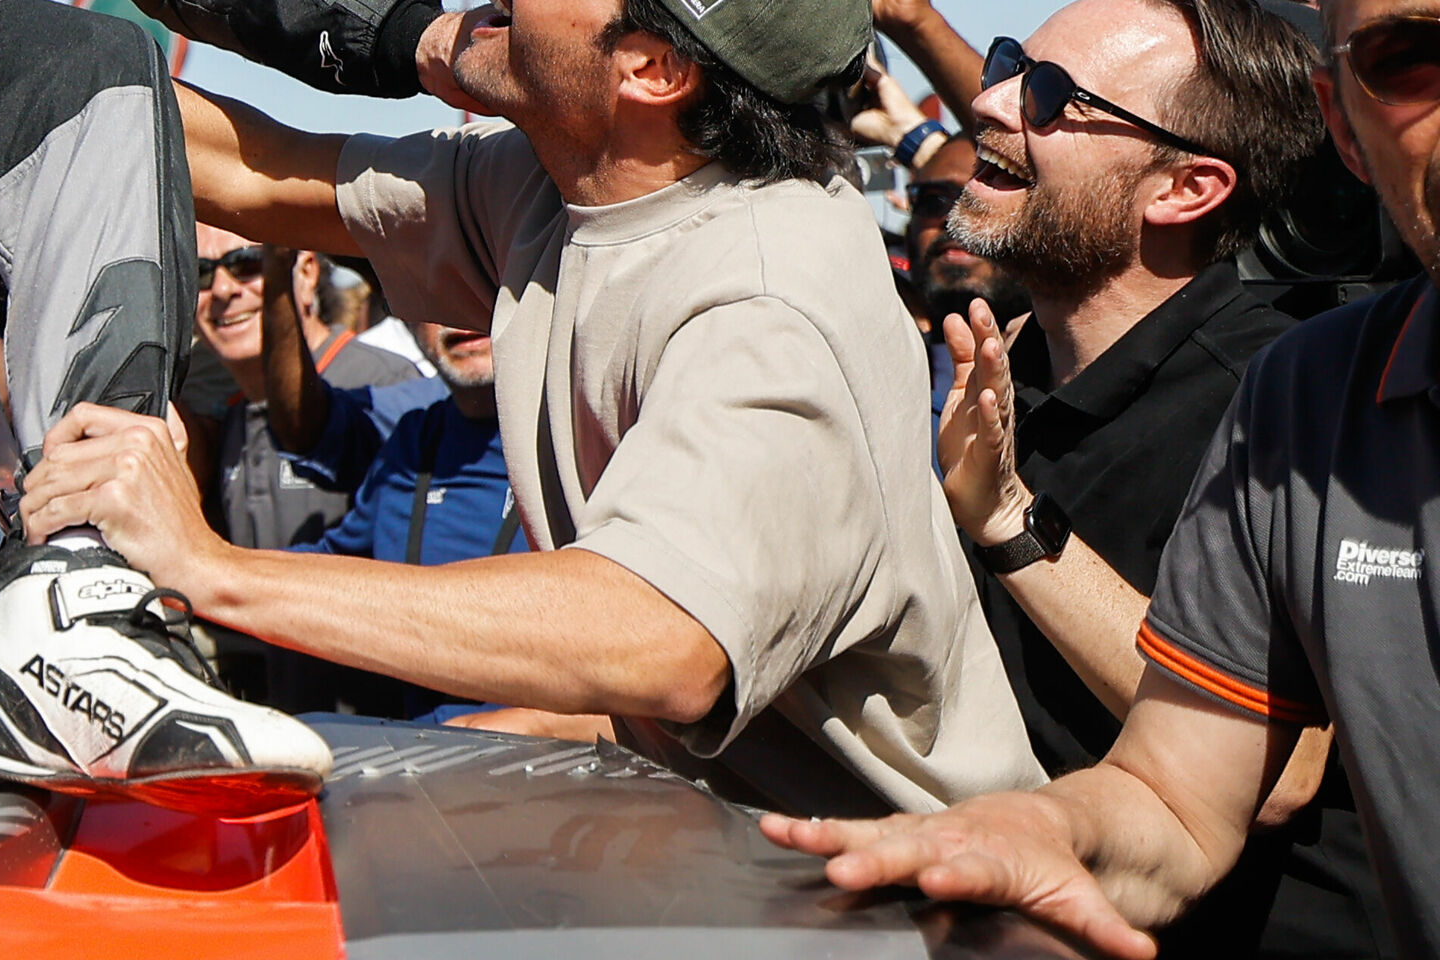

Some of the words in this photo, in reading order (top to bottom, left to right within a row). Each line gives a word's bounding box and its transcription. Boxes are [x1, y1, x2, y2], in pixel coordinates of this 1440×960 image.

[1339, 539, 1423, 567] Diverse
[1333, 570, 1370, 586] .com
[1336, 559, 1422, 580] ExtremeTeam
[19, 653, 126, 745] ASTARS
